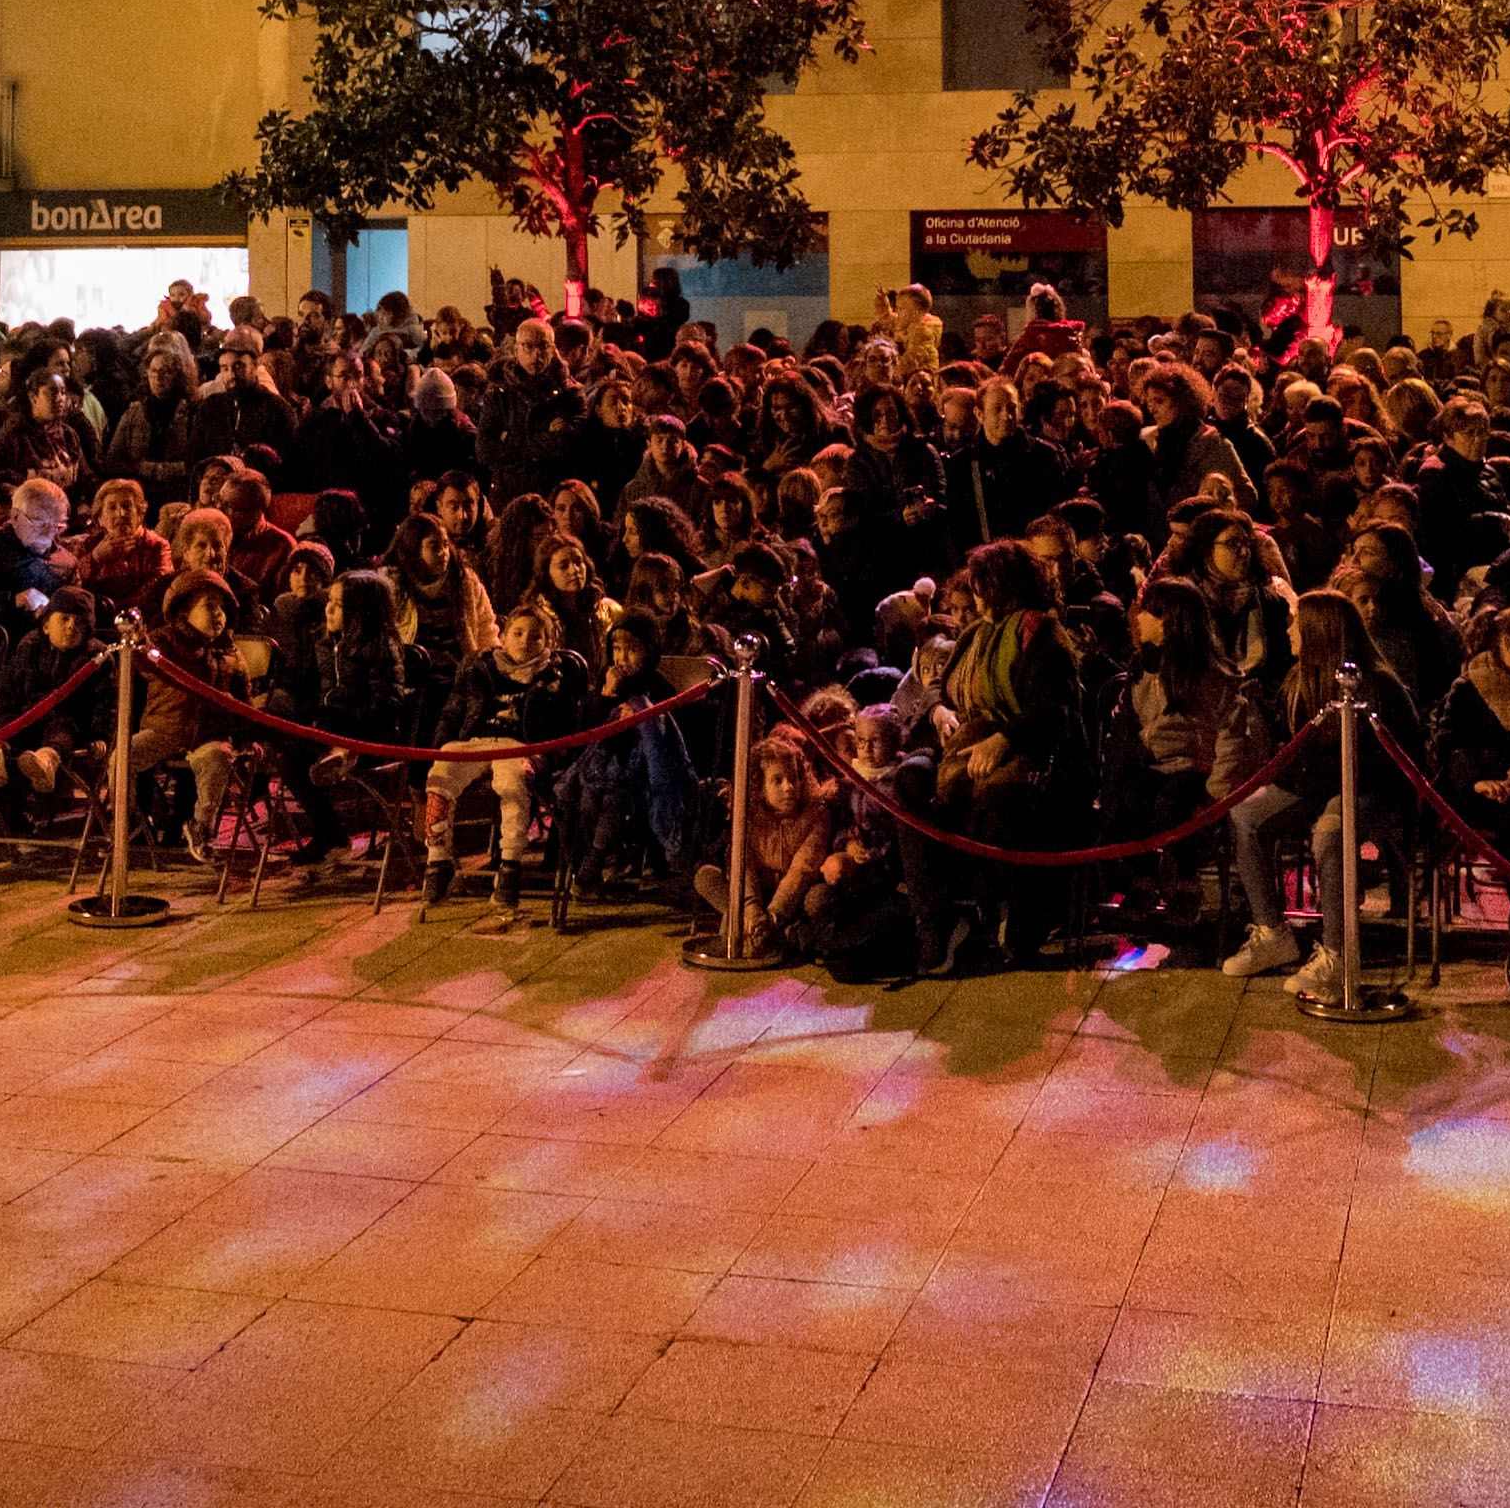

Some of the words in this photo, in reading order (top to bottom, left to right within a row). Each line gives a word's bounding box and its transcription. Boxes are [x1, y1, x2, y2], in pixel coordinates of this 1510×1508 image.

[925, 217, 965, 229] Oficina
[967, 216, 1020, 229] d'Atenció
[925, 235, 934, 245] a
[936, 234, 947, 245] la
[950, 234, 1012, 245] Ciutadania
